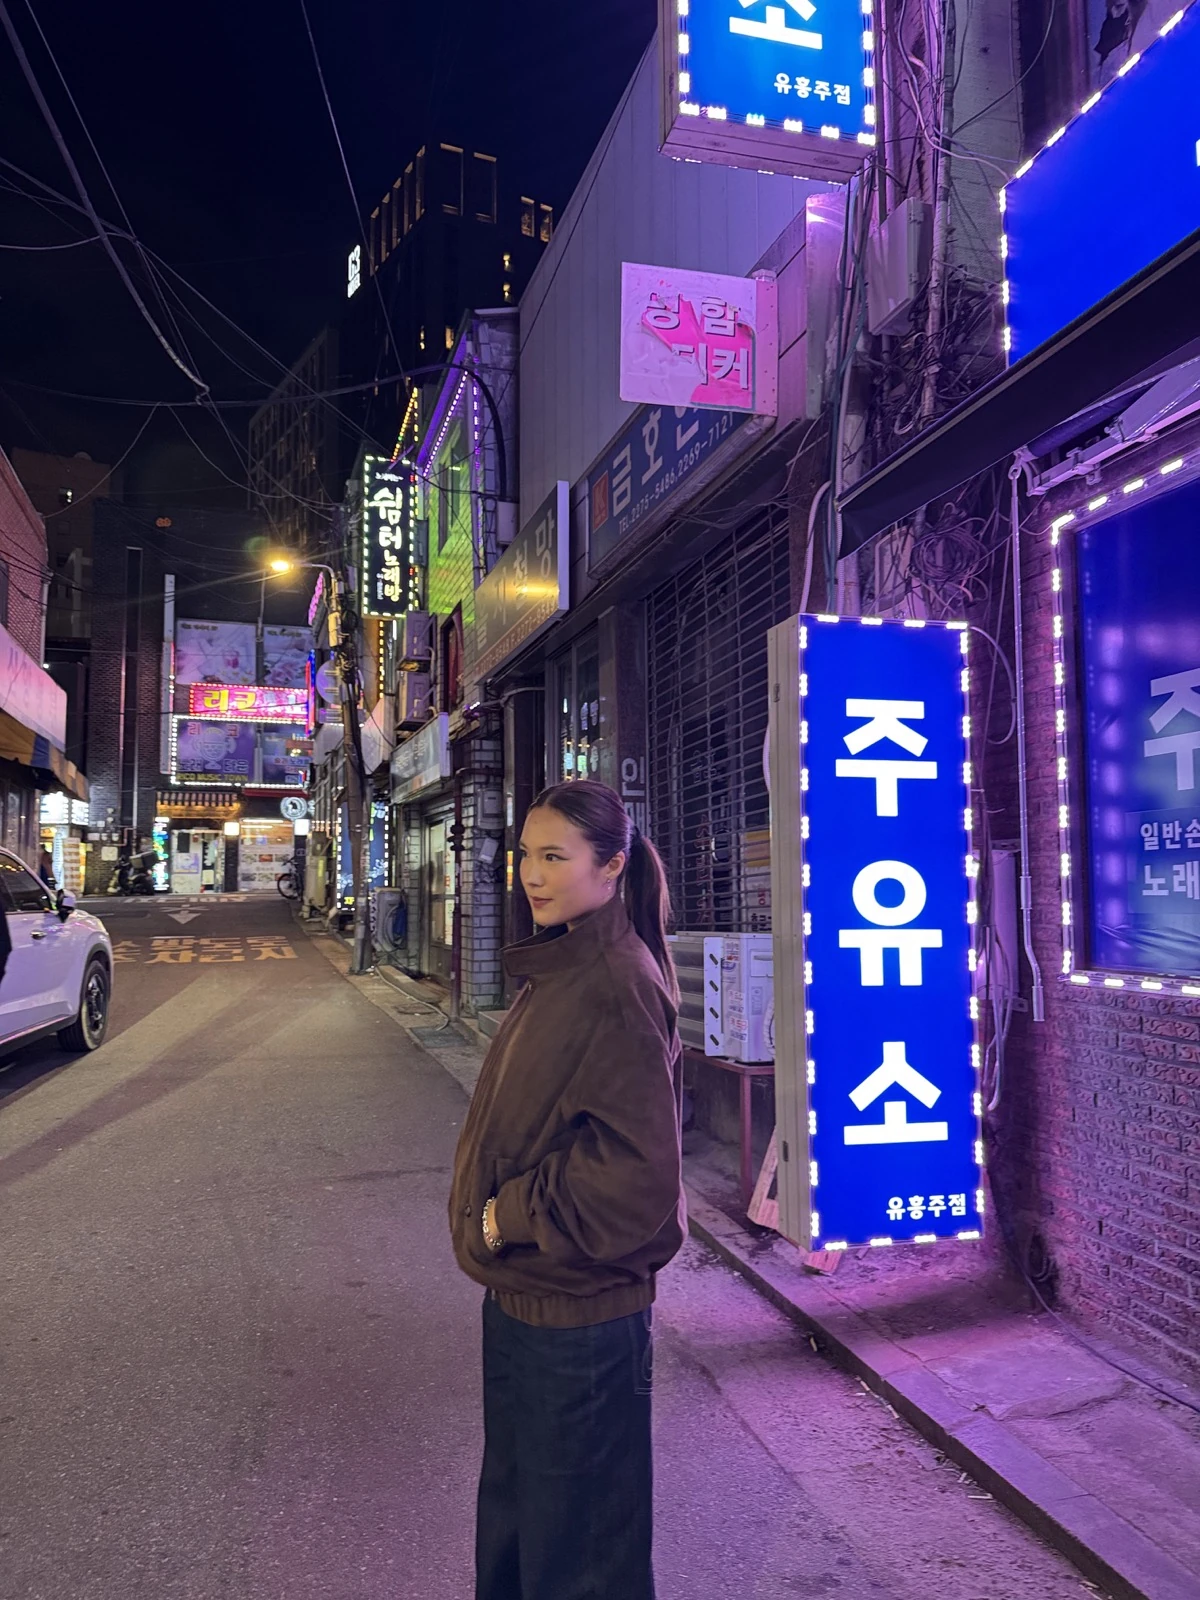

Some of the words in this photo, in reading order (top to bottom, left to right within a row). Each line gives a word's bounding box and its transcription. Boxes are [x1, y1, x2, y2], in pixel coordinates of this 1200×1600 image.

[773, 72, 851, 106] 유흥주점
[203, 689, 257, 713] 리코
[835, 698, 949, 1146] 주유소
[886, 1193, 966, 1221] 유흥주점
